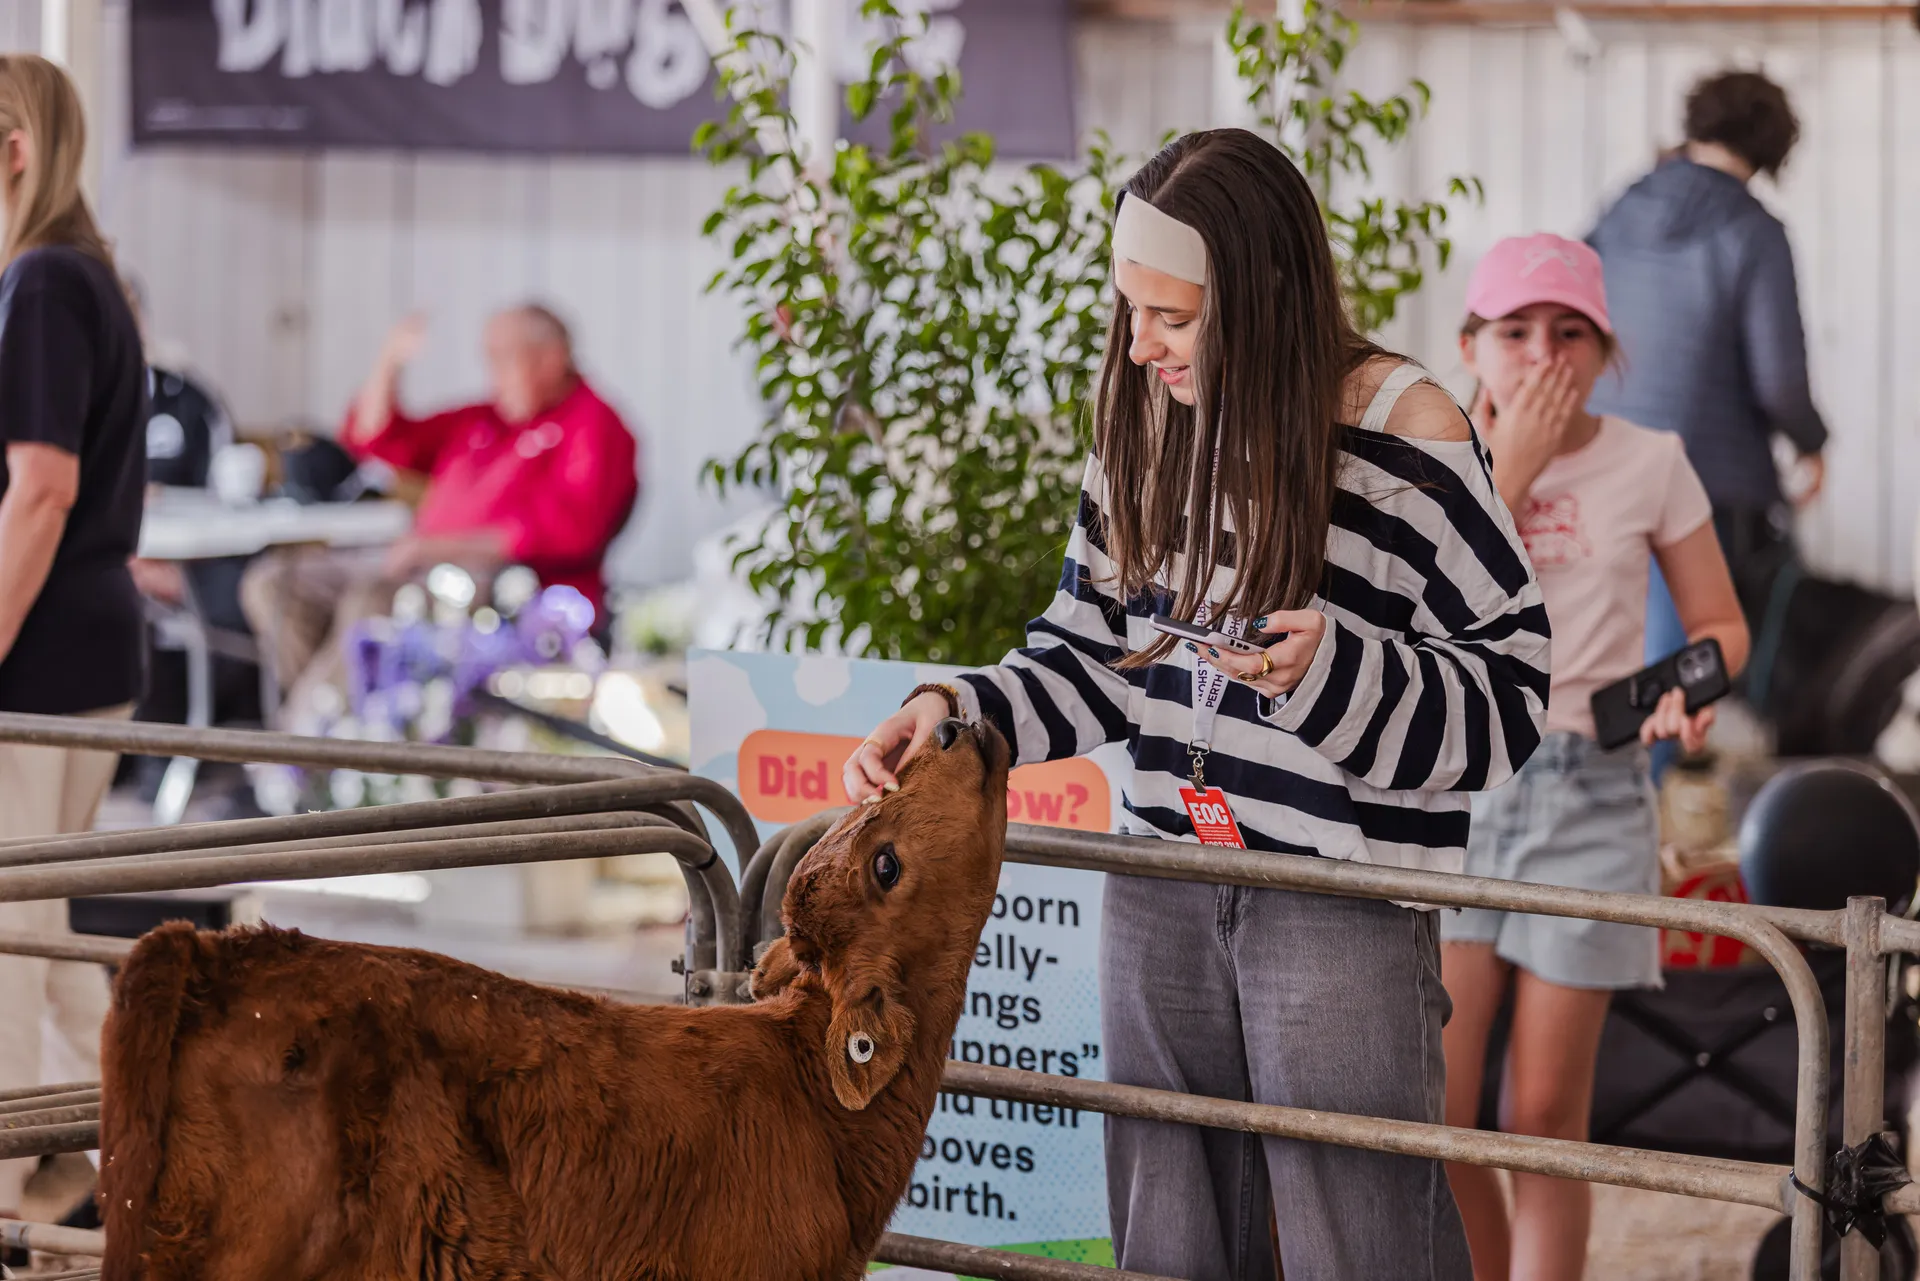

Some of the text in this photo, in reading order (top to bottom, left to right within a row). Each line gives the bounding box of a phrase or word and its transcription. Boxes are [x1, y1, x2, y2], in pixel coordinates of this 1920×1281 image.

[1205, 674, 1224, 708] PERTH
[758, 755, 1089, 824] Did ow?
[1188, 802, 1229, 825] EOC
[991, 893, 1079, 927] born
[974, 933, 1059, 982] elly-
[920, 1135, 1034, 1173] ooves
